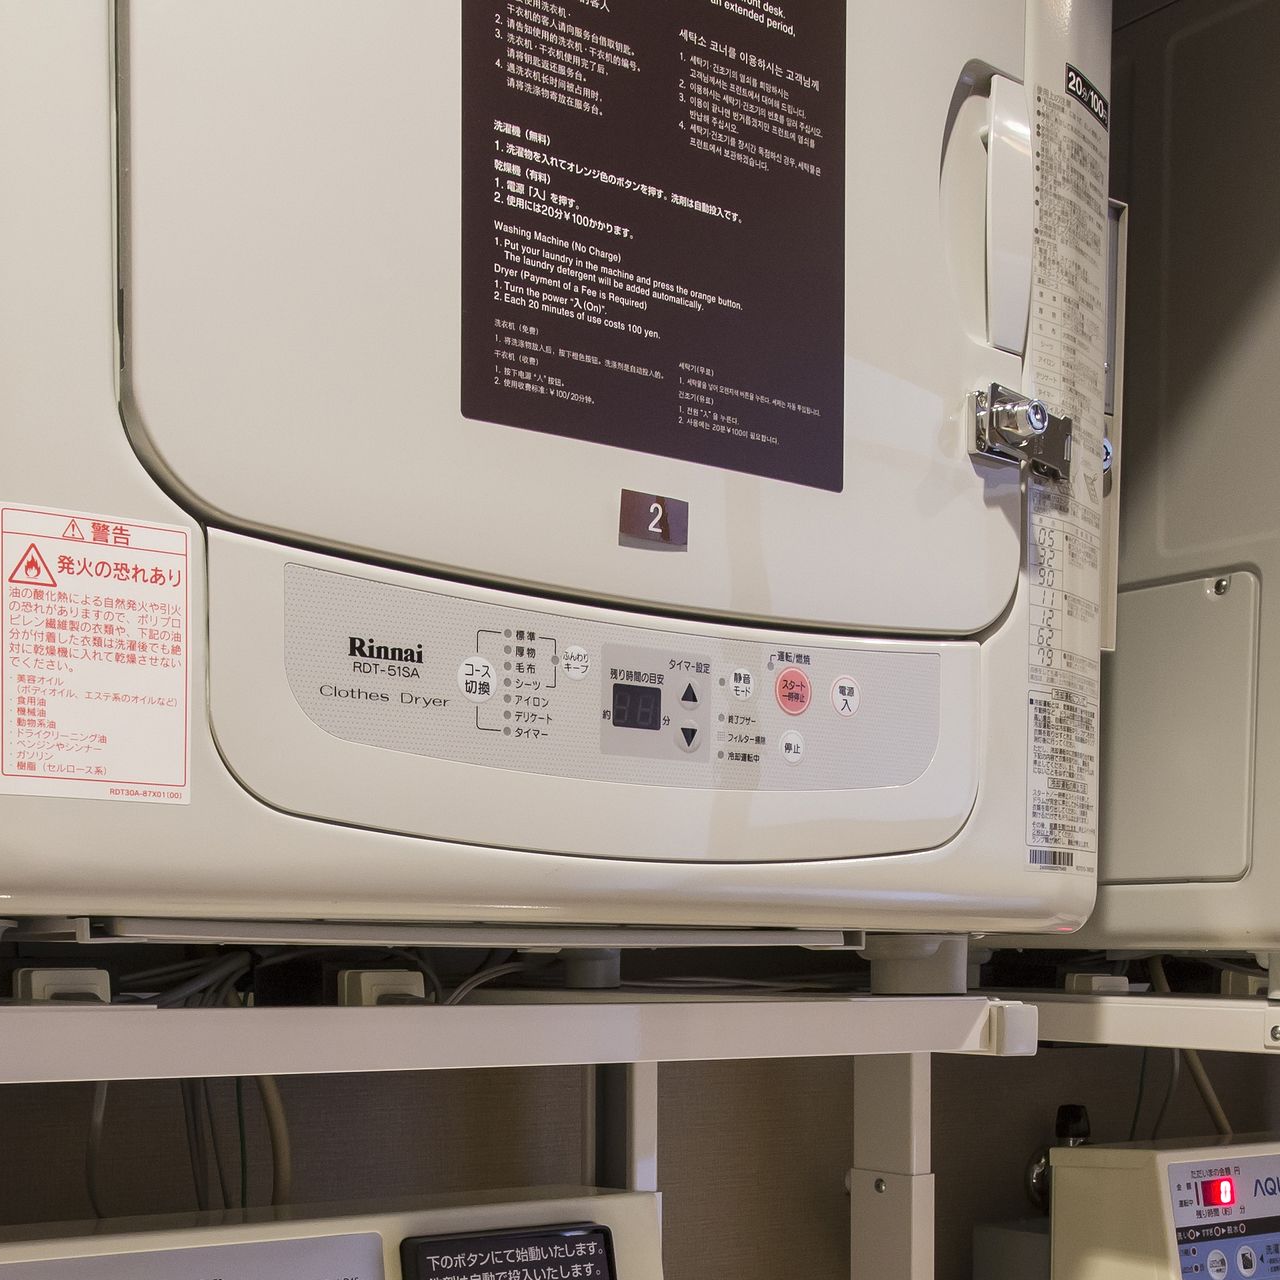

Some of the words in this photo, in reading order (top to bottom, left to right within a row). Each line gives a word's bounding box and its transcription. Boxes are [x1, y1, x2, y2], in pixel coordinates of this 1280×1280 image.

[763, 2, 786, 19] desk.
[724, 2, 765, 24] extended
[767, 18, 796, 37] period.
[679, 28, 707, 47] 세탁소
[740, 52, 784, 78] 이용하시는
[494, 220, 532, 240] Washing
[534, 231, 569, 249] Machine
[571, 241, 587, 253] (No
[588, 246, 622, 263] Charge)
[504, 239, 519, 251] Put
[521, 244, 540, 255] your
[542, 249, 574, 266] laundry
[576, 258, 584, 267] in
[585, 261, 599, 272] the
[600, 266, 634, 281] machine
[636, 275, 651, 285] and
[653, 280, 675, 292] press
[676, 285, 689, 296] the
[690, 290, 716, 304] orange
[718, 296, 743, 311] button.
[504, 250, 521, 263] The
[523, 255, 554, 273] laundry
[557, 265, 596, 282] detergent
[598, 276, 612, 287] will
[613, 279, 624, 290] be
[626, 283, 651, 296] added
[652, 291, 704, 311] automatically.
[494, 263, 518, 278] Dryer
[520, 269, 561, 288] (Payment
[563, 281, 572, 291] of
[573, 285, 579, 293] a
[581, 285, 597, 297] Fee
[599, 289, 607, 300] is
[608, 292, 648, 311] Required)
[504, 293, 527, 307] Each
[528, 299, 540, 310] 20
[542, 304, 575, 319] minutes
[576, 311, 585, 320] of
[587, 315, 602, 325] use
[604, 318, 626, 331] costs
[627, 323, 643, 335] 100
[644, 328, 661, 340] yen.
[648, 502, 664, 533] 2
[91, 522, 131, 546] 警告
[57, 554, 181, 587] 発火の恐れあり
[515, 630, 536, 641] 標準
[348, 636, 424, 664] Rinnai
[515, 646, 536, 659] 厚物
[562, 650, 590, 663] ふんわり
[353, 661, 420, 679] RDT-51SA
[464, 664, 491, 678] コース
[515, 662, 536, 675] 毛布
[563, 662, 590, 674] キープ
[669, 659, 711, 675] タイマー設定
[17, 674, 64, 686] 美容オイル
[610, 668, 665, 686] 残り時間の目安
[733, 672, 751, 685] 静音
[464, 680, 491, 696] 切換
[515, 679, 541, 691] シーツ
[733, 685, 751, 698] モード
[782, 678, 806, 692] スタート
[838, 685, 855, 698] 電源
[17, 696, 47, 707] 食用油
[319, 684, 390, 702] Clothes
[400, 692, 451, 708] Dryer
[515, 695, 550, 708] アイロン
[17, 707, 47, 718] 機械油
[514, 711, 553, 725] デリケート
[515, 728, 549, 739] タイマー
[784, 742, 801, 755] 停止
[427, 1241, 603, 1272] 下のボタンにて始動いたします。
